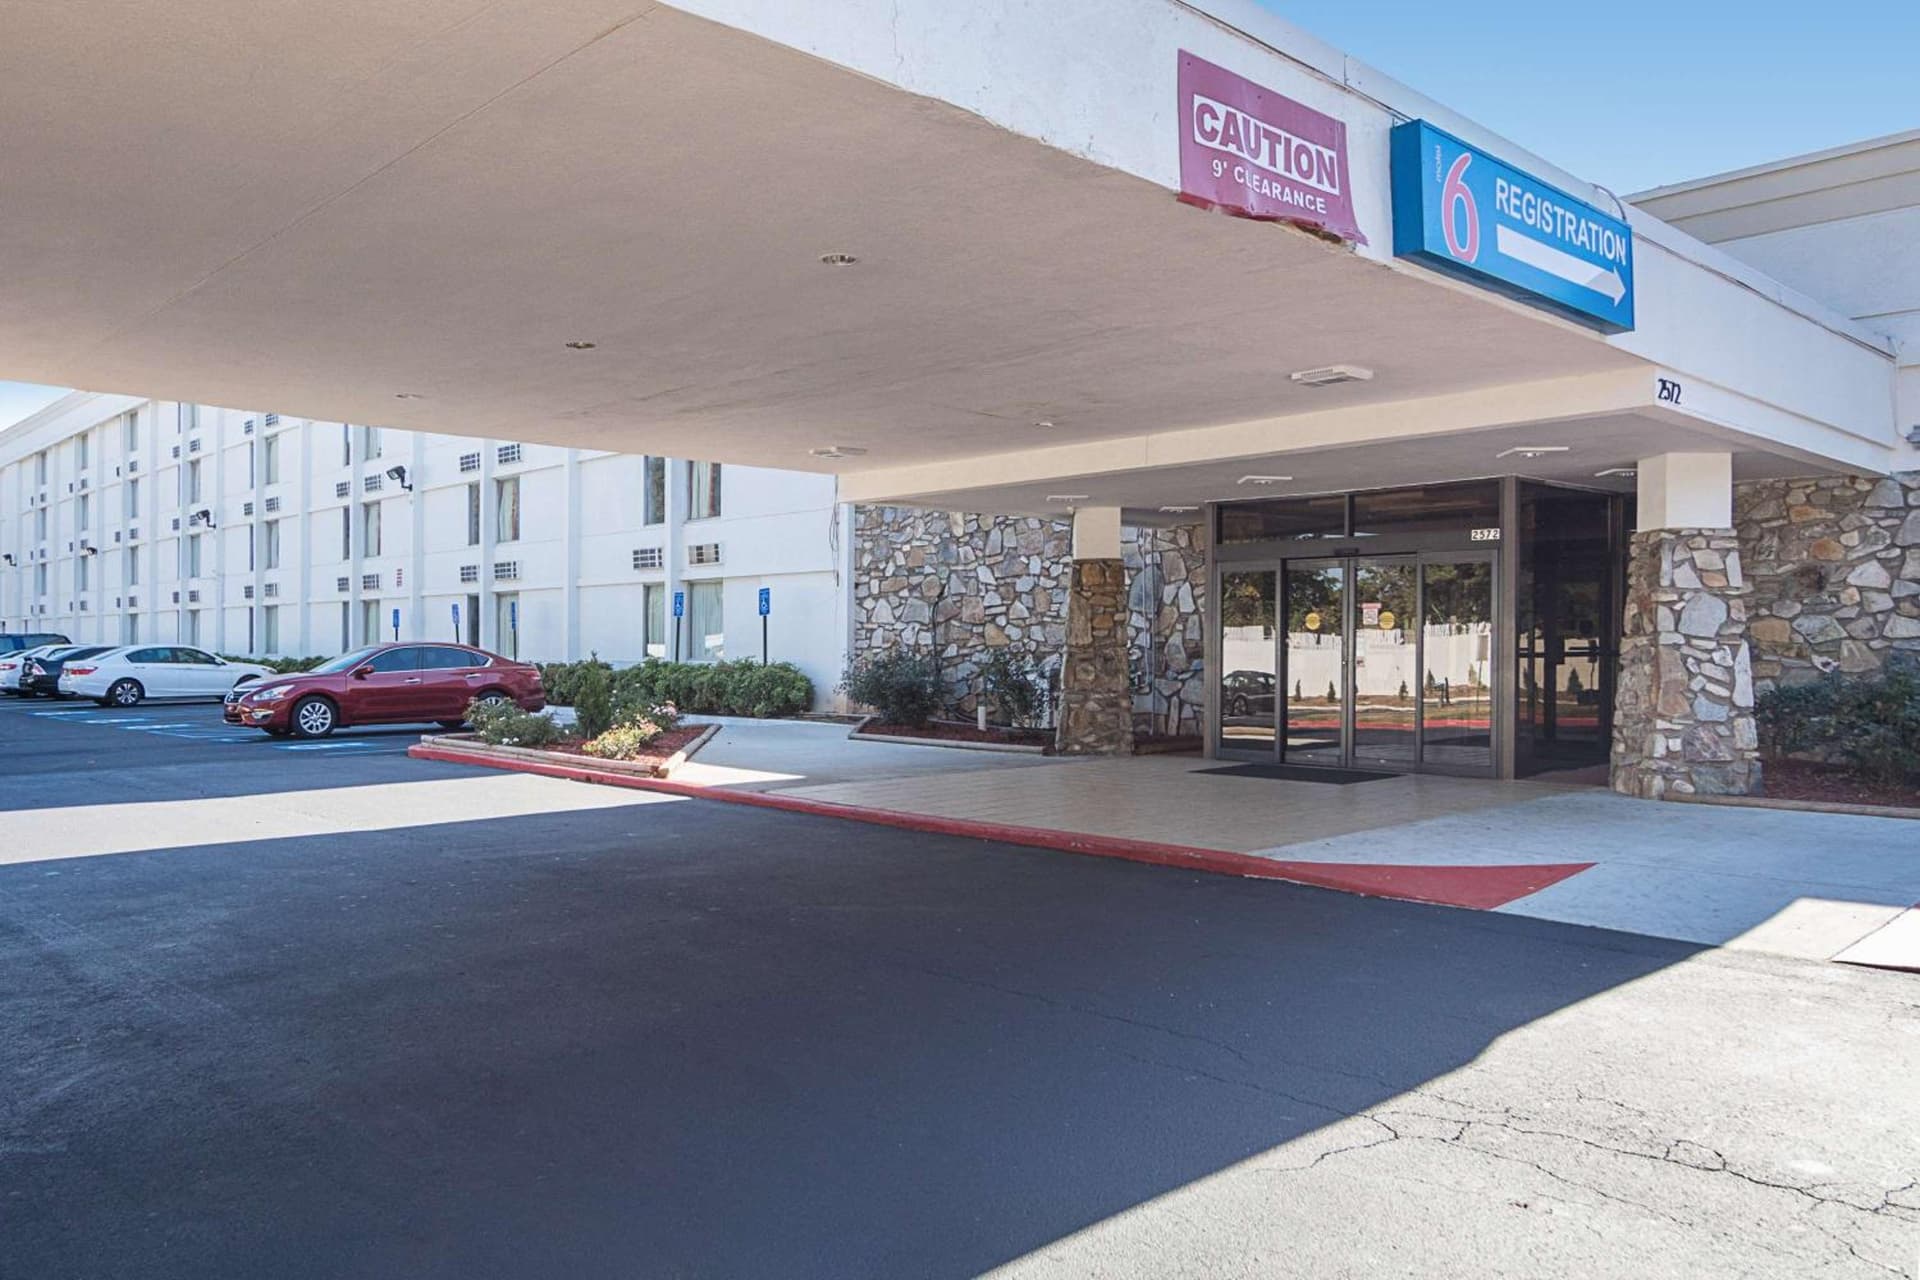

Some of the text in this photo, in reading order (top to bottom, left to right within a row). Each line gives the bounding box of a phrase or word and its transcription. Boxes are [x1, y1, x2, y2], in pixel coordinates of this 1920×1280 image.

[1195, 102, 1337, 189] CAUTION
[1233, 165, 1327, 214] CLEARANCE
[1441, 152, 1480, 264] 6
[1495, 177, 1627, 266] REGISTRATION
[1657, 378, 1682, 405] 2572
[1472, 529, 1499, 540] 2572
